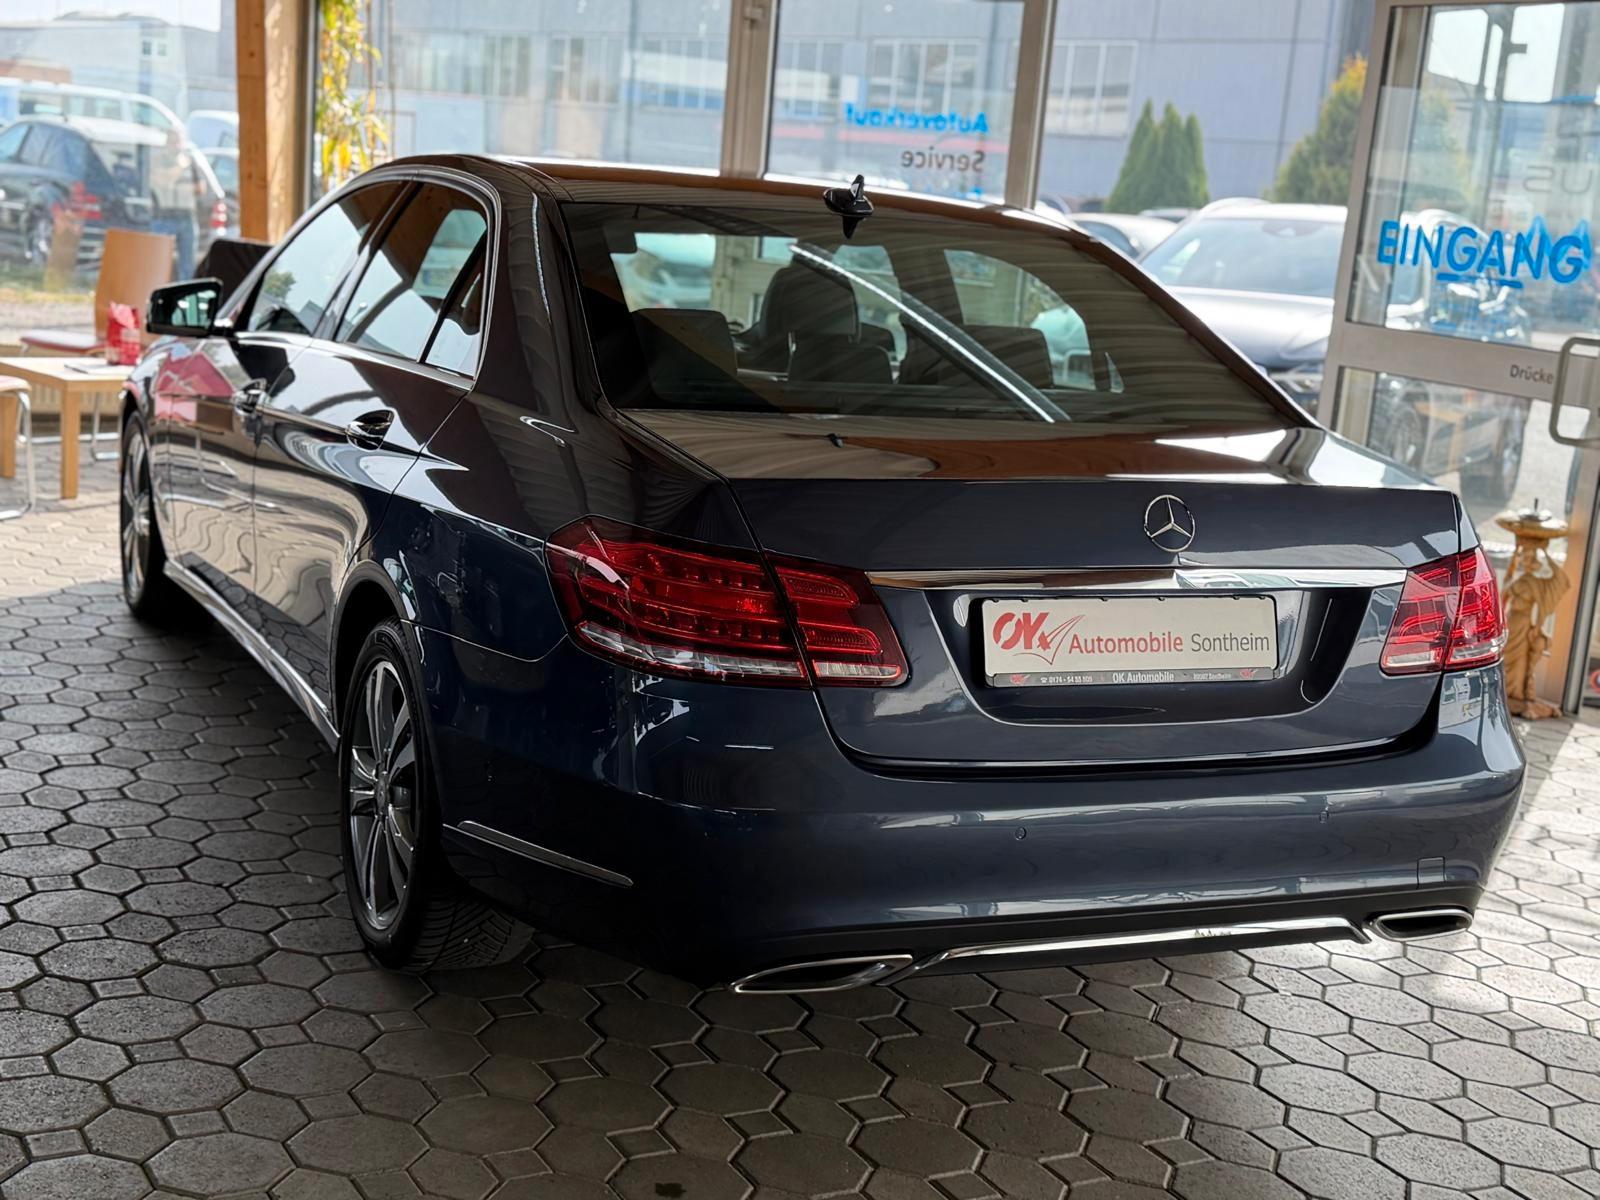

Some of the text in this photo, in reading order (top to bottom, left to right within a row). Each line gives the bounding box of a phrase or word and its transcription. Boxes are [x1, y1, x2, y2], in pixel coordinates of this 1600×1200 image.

[1377, 220, 1585, 284] EINGANG
[1510, 364, 1555, 385] Drücke
[992, 612, 1270, 654] OK Automobile Sontheim
[1112, 672, 1126, 684] OK
[1128, 671, 1175, 683] Automobile
